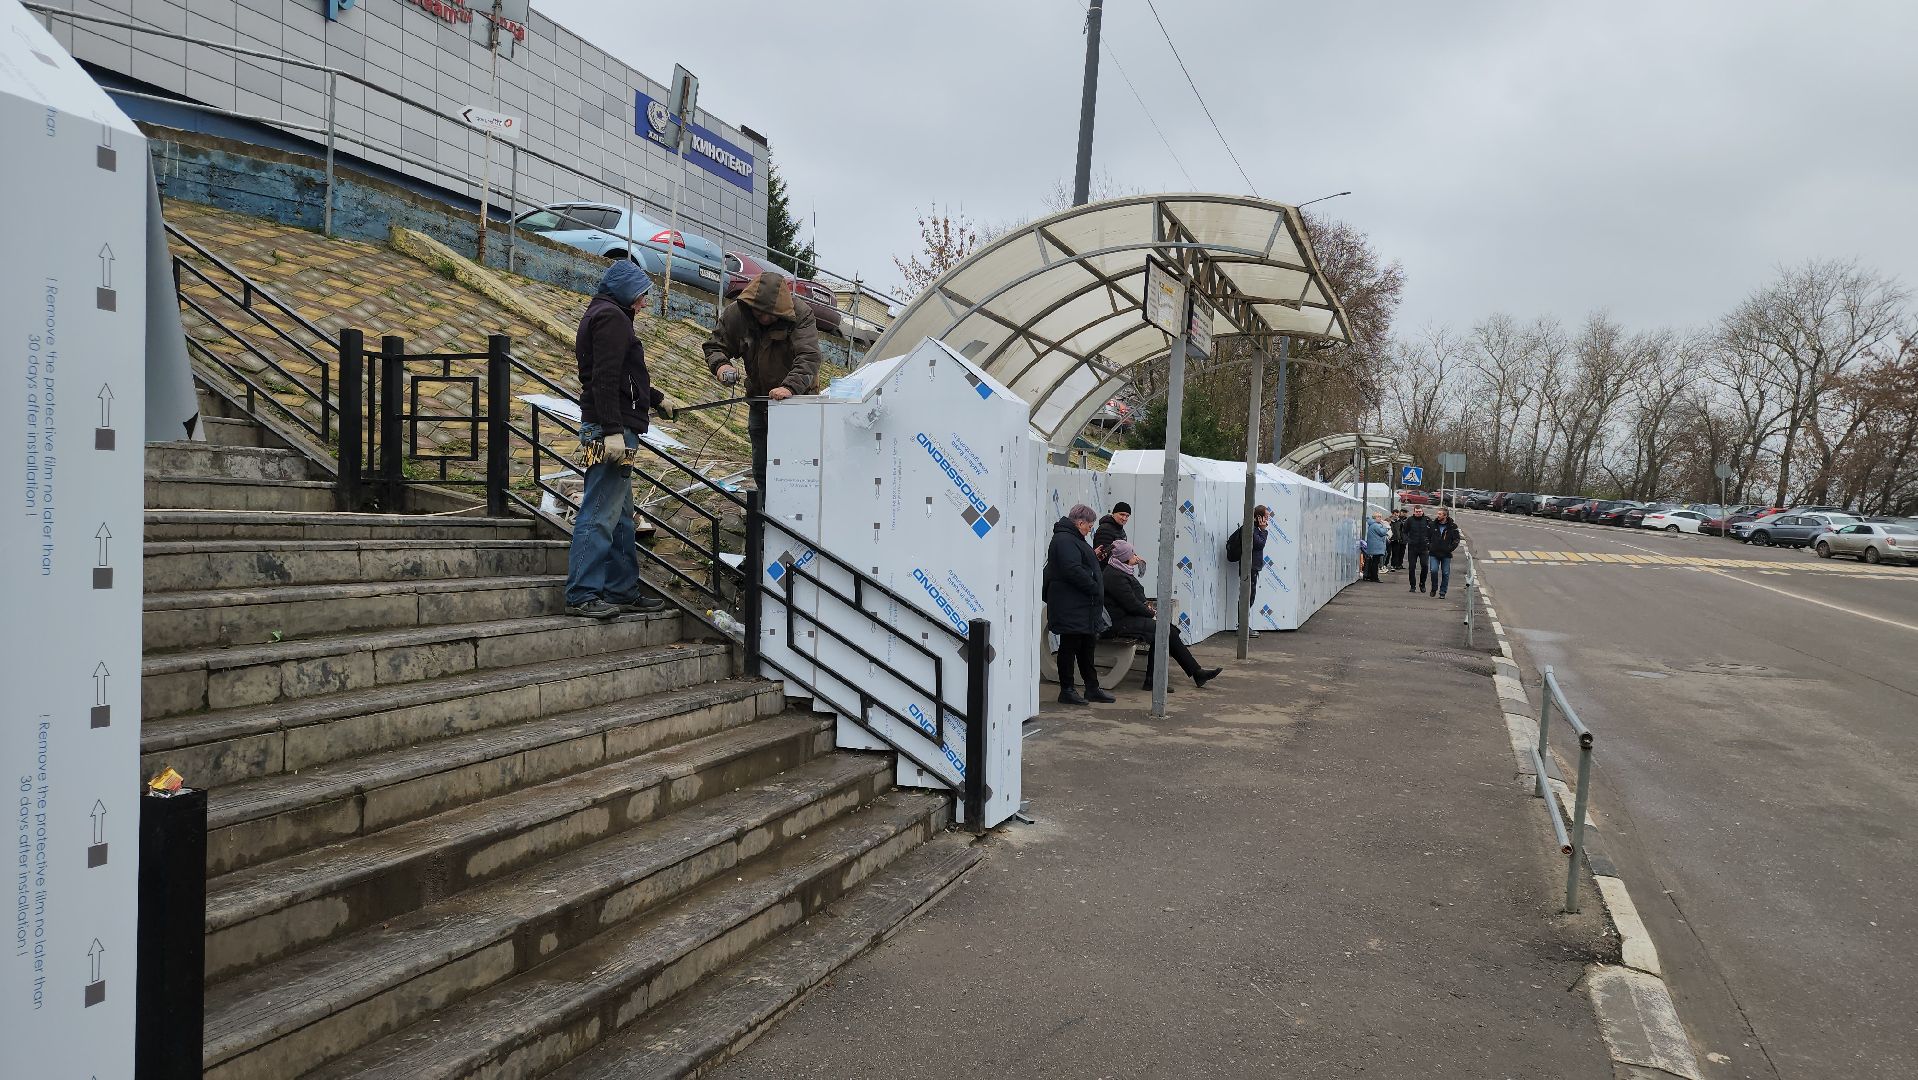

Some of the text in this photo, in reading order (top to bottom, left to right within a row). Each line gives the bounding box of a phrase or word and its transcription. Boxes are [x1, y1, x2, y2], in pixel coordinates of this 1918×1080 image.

[46, 107, 58, 137] han
[692, 134, 753, 177] КИНОТЕАТР
[46, 285, 58, 346] Remove
[28, 334, 41, 352] 30
[26, 354, 39, 389] days
[45, 351, 57, 374] the
[27, 393, 40, 429] after
[43, 377, 56, 452] protective
[26, 432, 39, 508] installation
[43, 456, 56, 480] film
[917, 433, 988, 513] GROSSBOND
[43, 484, 53, 503] no
[42, 507, 55, 539] later
[42, 544, 54, 576] than
[913, 568, 969, 636] OSSBOND
[38, 721, 50, 781] Remove
[20, 775, 32, 792] 30
[37, 785, 49, 809] the
[18, 796, 31, 831] days
[19, 834, 31, 868] after
[35, 813, 47, 887] protective
[17, 871, 31, 949] installation
[35, 890, 47, 916] film
[34, 918, 44, 938] no
[34, 939, 47, 972] later
[33, 976, 46, 1010] than
